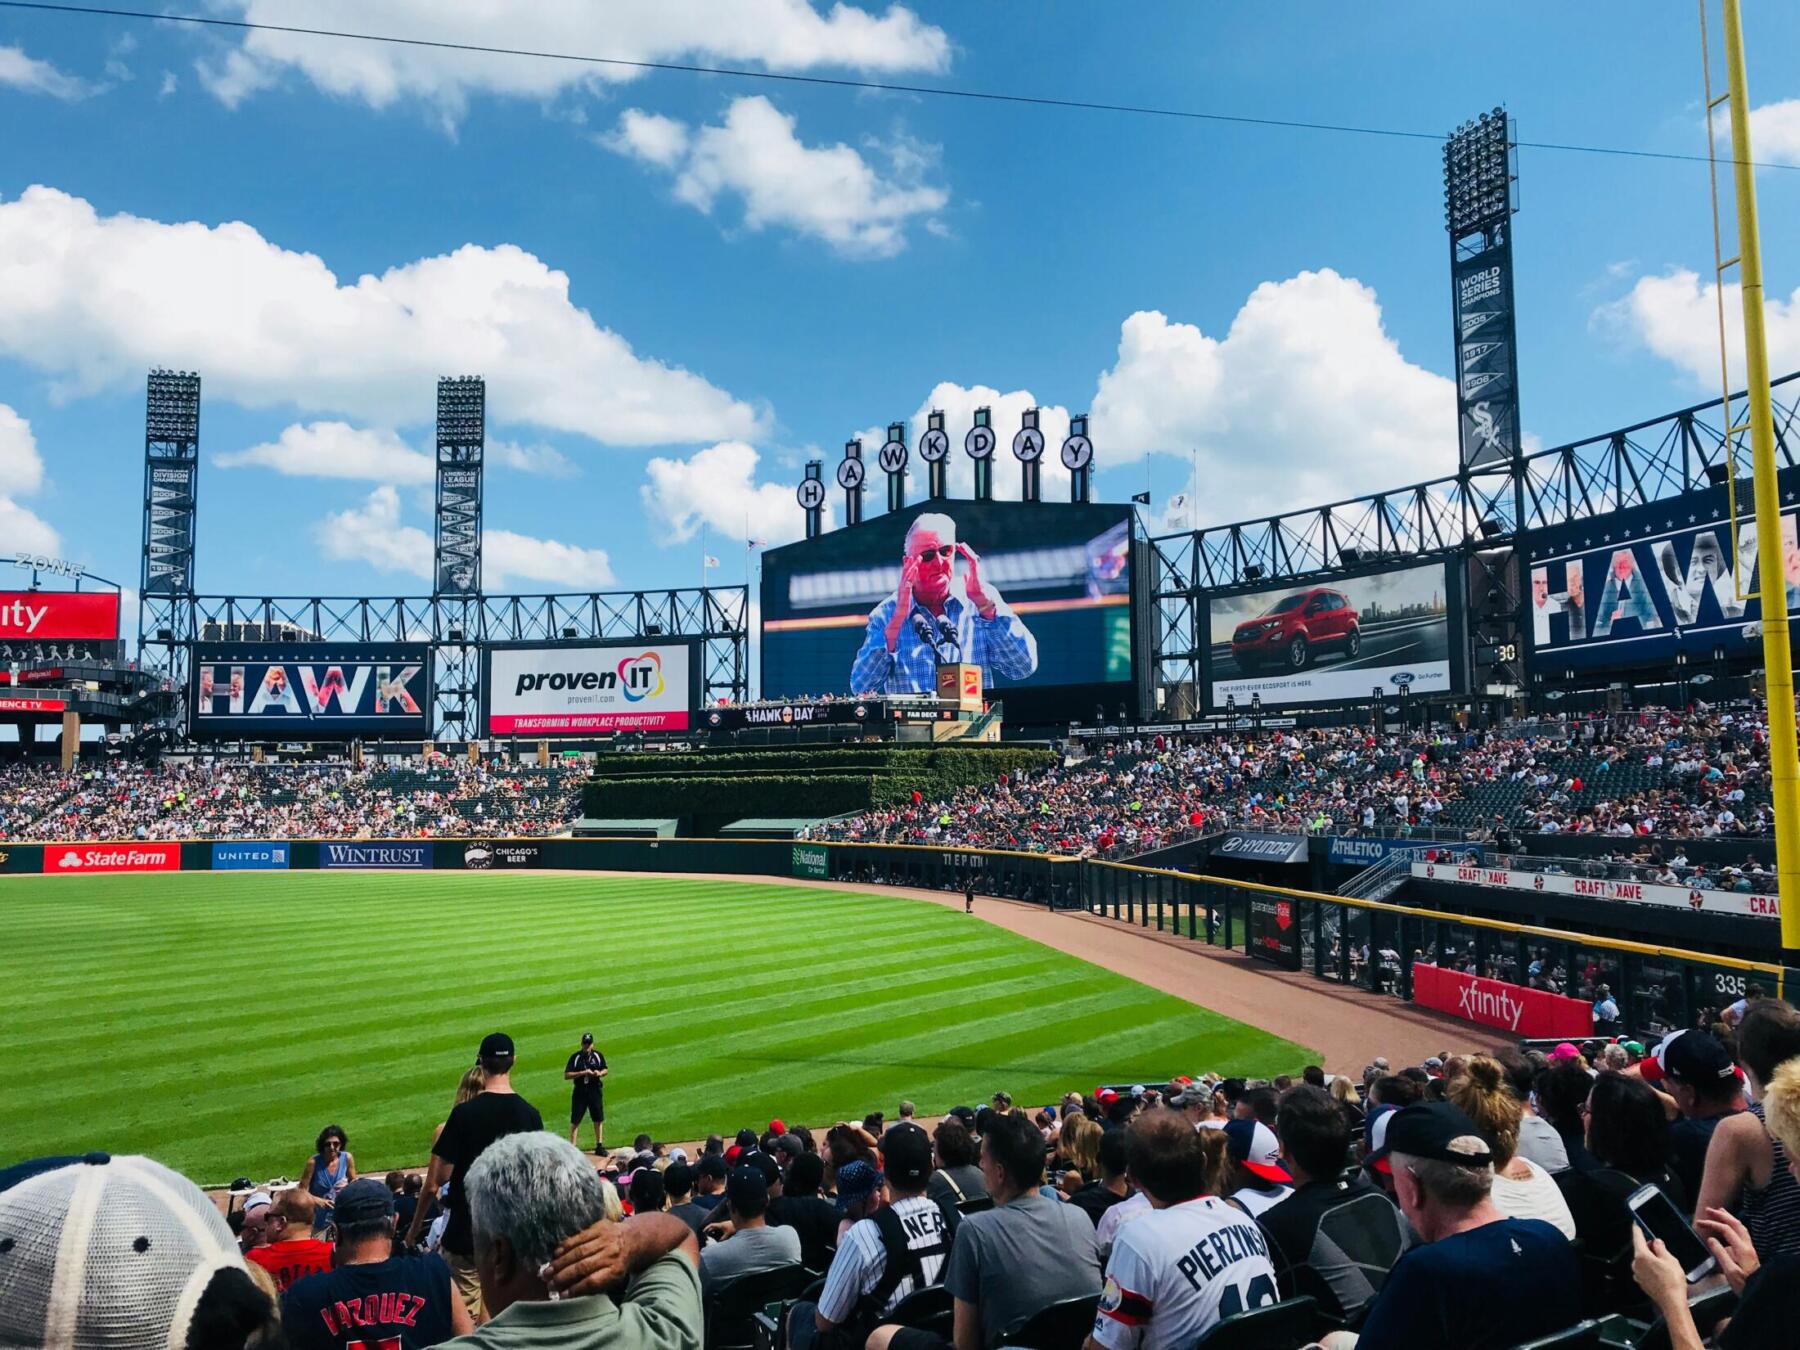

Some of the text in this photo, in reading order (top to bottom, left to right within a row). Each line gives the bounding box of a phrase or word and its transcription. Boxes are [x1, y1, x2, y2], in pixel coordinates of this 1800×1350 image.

[1460, 266, 1500, 289] WORLD
[1461, 277, 1500, 301] SERIES
[1462, 288, 1500, 307] CHAMPIONS
[1463, 314, 1487, 329] 2005
[1465, 345, 1488, 359] 1917
[928, 436, 941, 455] K
[974, 434, 987, 452] D
[1021, 435, 1037, 454] A
[1070, 443, 1084, 462] Y
[883, 447, 903, 466] W
[844, 465, 858, 483] A
[804, 486, 817, 502] H
[14, 552, 84, 580] ZONE
[1531, 513, 1800, 646] HAW
[199, 666, 422, 713] HAWK
[515, 667, 652, 696] proven IT
[514, 716, 666, 728] TRANSFORMING WORKPLACE PRODUCTIVITY
[752, 710, 781, 722] HAWK
[794, 707, 814, 720] DAY
[218, 852, 269, 861] UNITED
[1238, 840, 1296, 856] HYUNDAI
[1332, 838, 1382, 858] ATHLETICO
[800, 850, 826, 866] National
[1458, 868, 1481, 882] CRAFT
[1574, 880, 1606, 896] CRAFT
[1750, 897, 1781, 914] CRA
[1715, 973, 1746, 996] 335
[1459, 980, 1524, 1031] xfinity
[320, 1292, 425, 1336] VAZQUEZ
